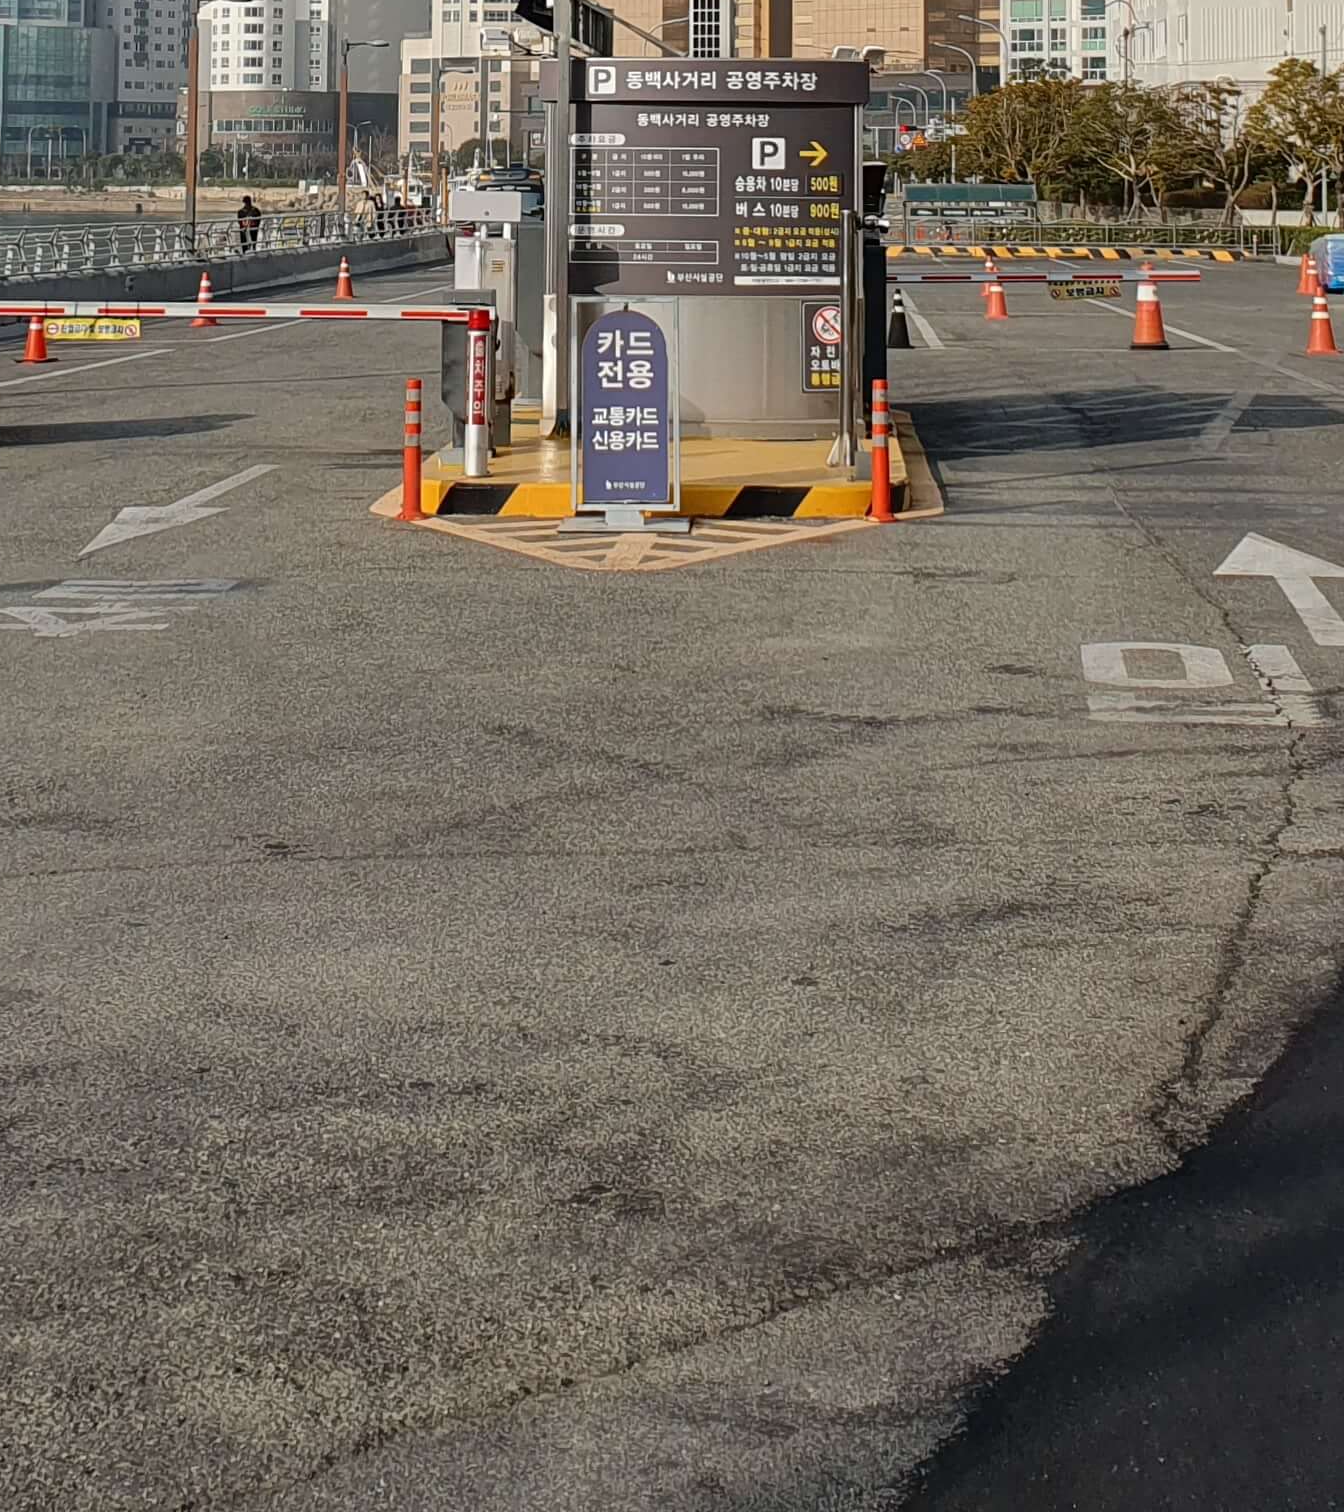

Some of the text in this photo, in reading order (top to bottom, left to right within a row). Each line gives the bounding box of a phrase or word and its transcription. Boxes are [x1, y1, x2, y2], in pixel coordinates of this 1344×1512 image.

[625, 70, 717, 90] 동백사거리
[725, 70, 818, 91] 공영주차장
[637, 113, 770, 128] 동백사거리 공영주차장
[735, 175, 838, 192] 승용차 10분당 500원
[770, 202, 799, 218] 10분당
[810, 202, 839, 219] 900원
[597, 329, 654, 358] 카드
[597, 360, 654, 389] 전용
[592, 406, 659, 426] 교통카드
[592, 430, 659, 451] 신용카드
